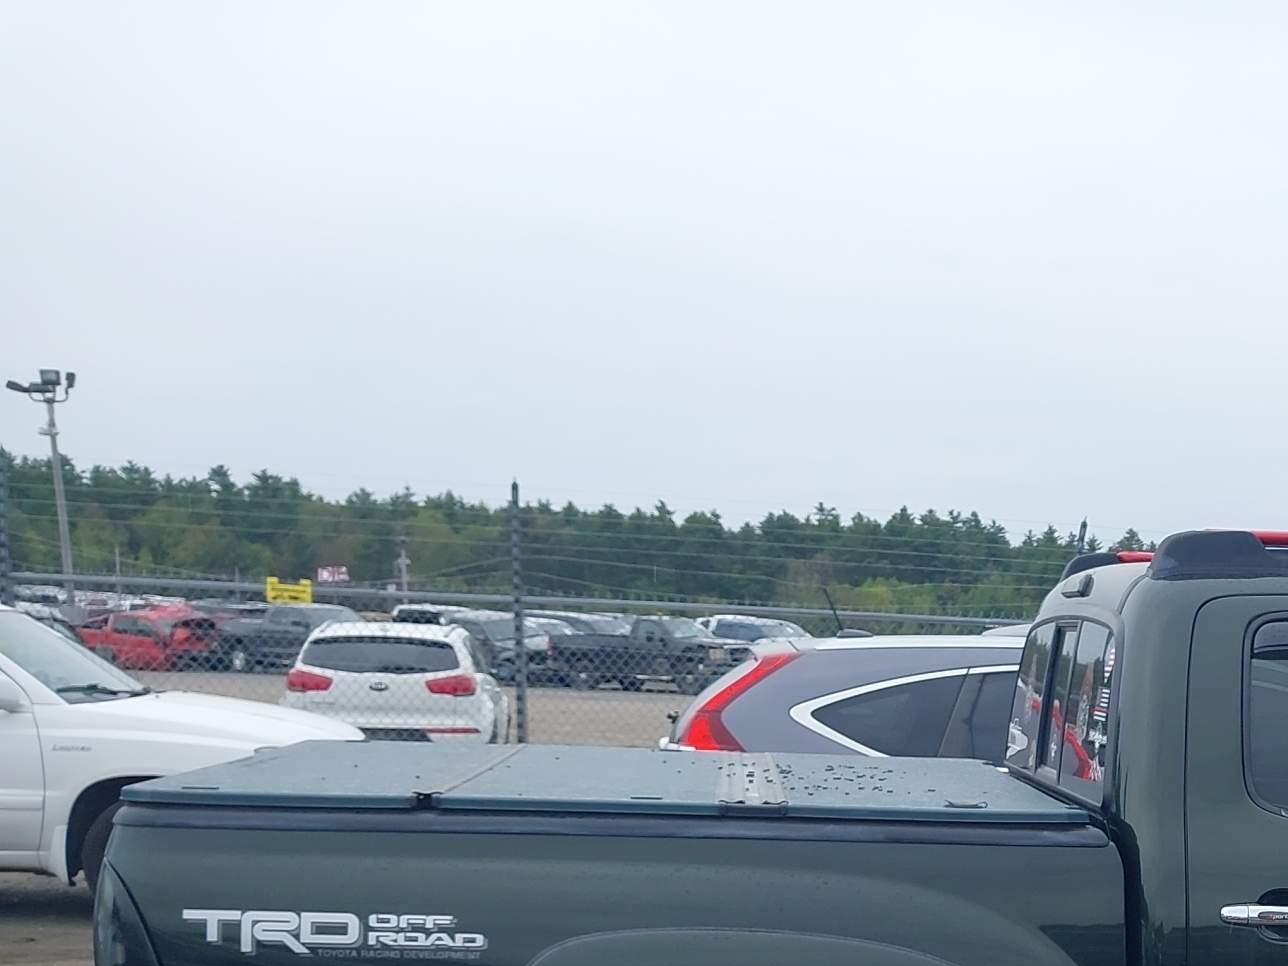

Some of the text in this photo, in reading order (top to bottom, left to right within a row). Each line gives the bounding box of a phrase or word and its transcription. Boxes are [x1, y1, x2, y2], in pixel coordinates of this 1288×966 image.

[367, 913, 455, 928] OFF
[182, 908, 362, 954] TRD
[366, 931, 487, 949] ROAD
